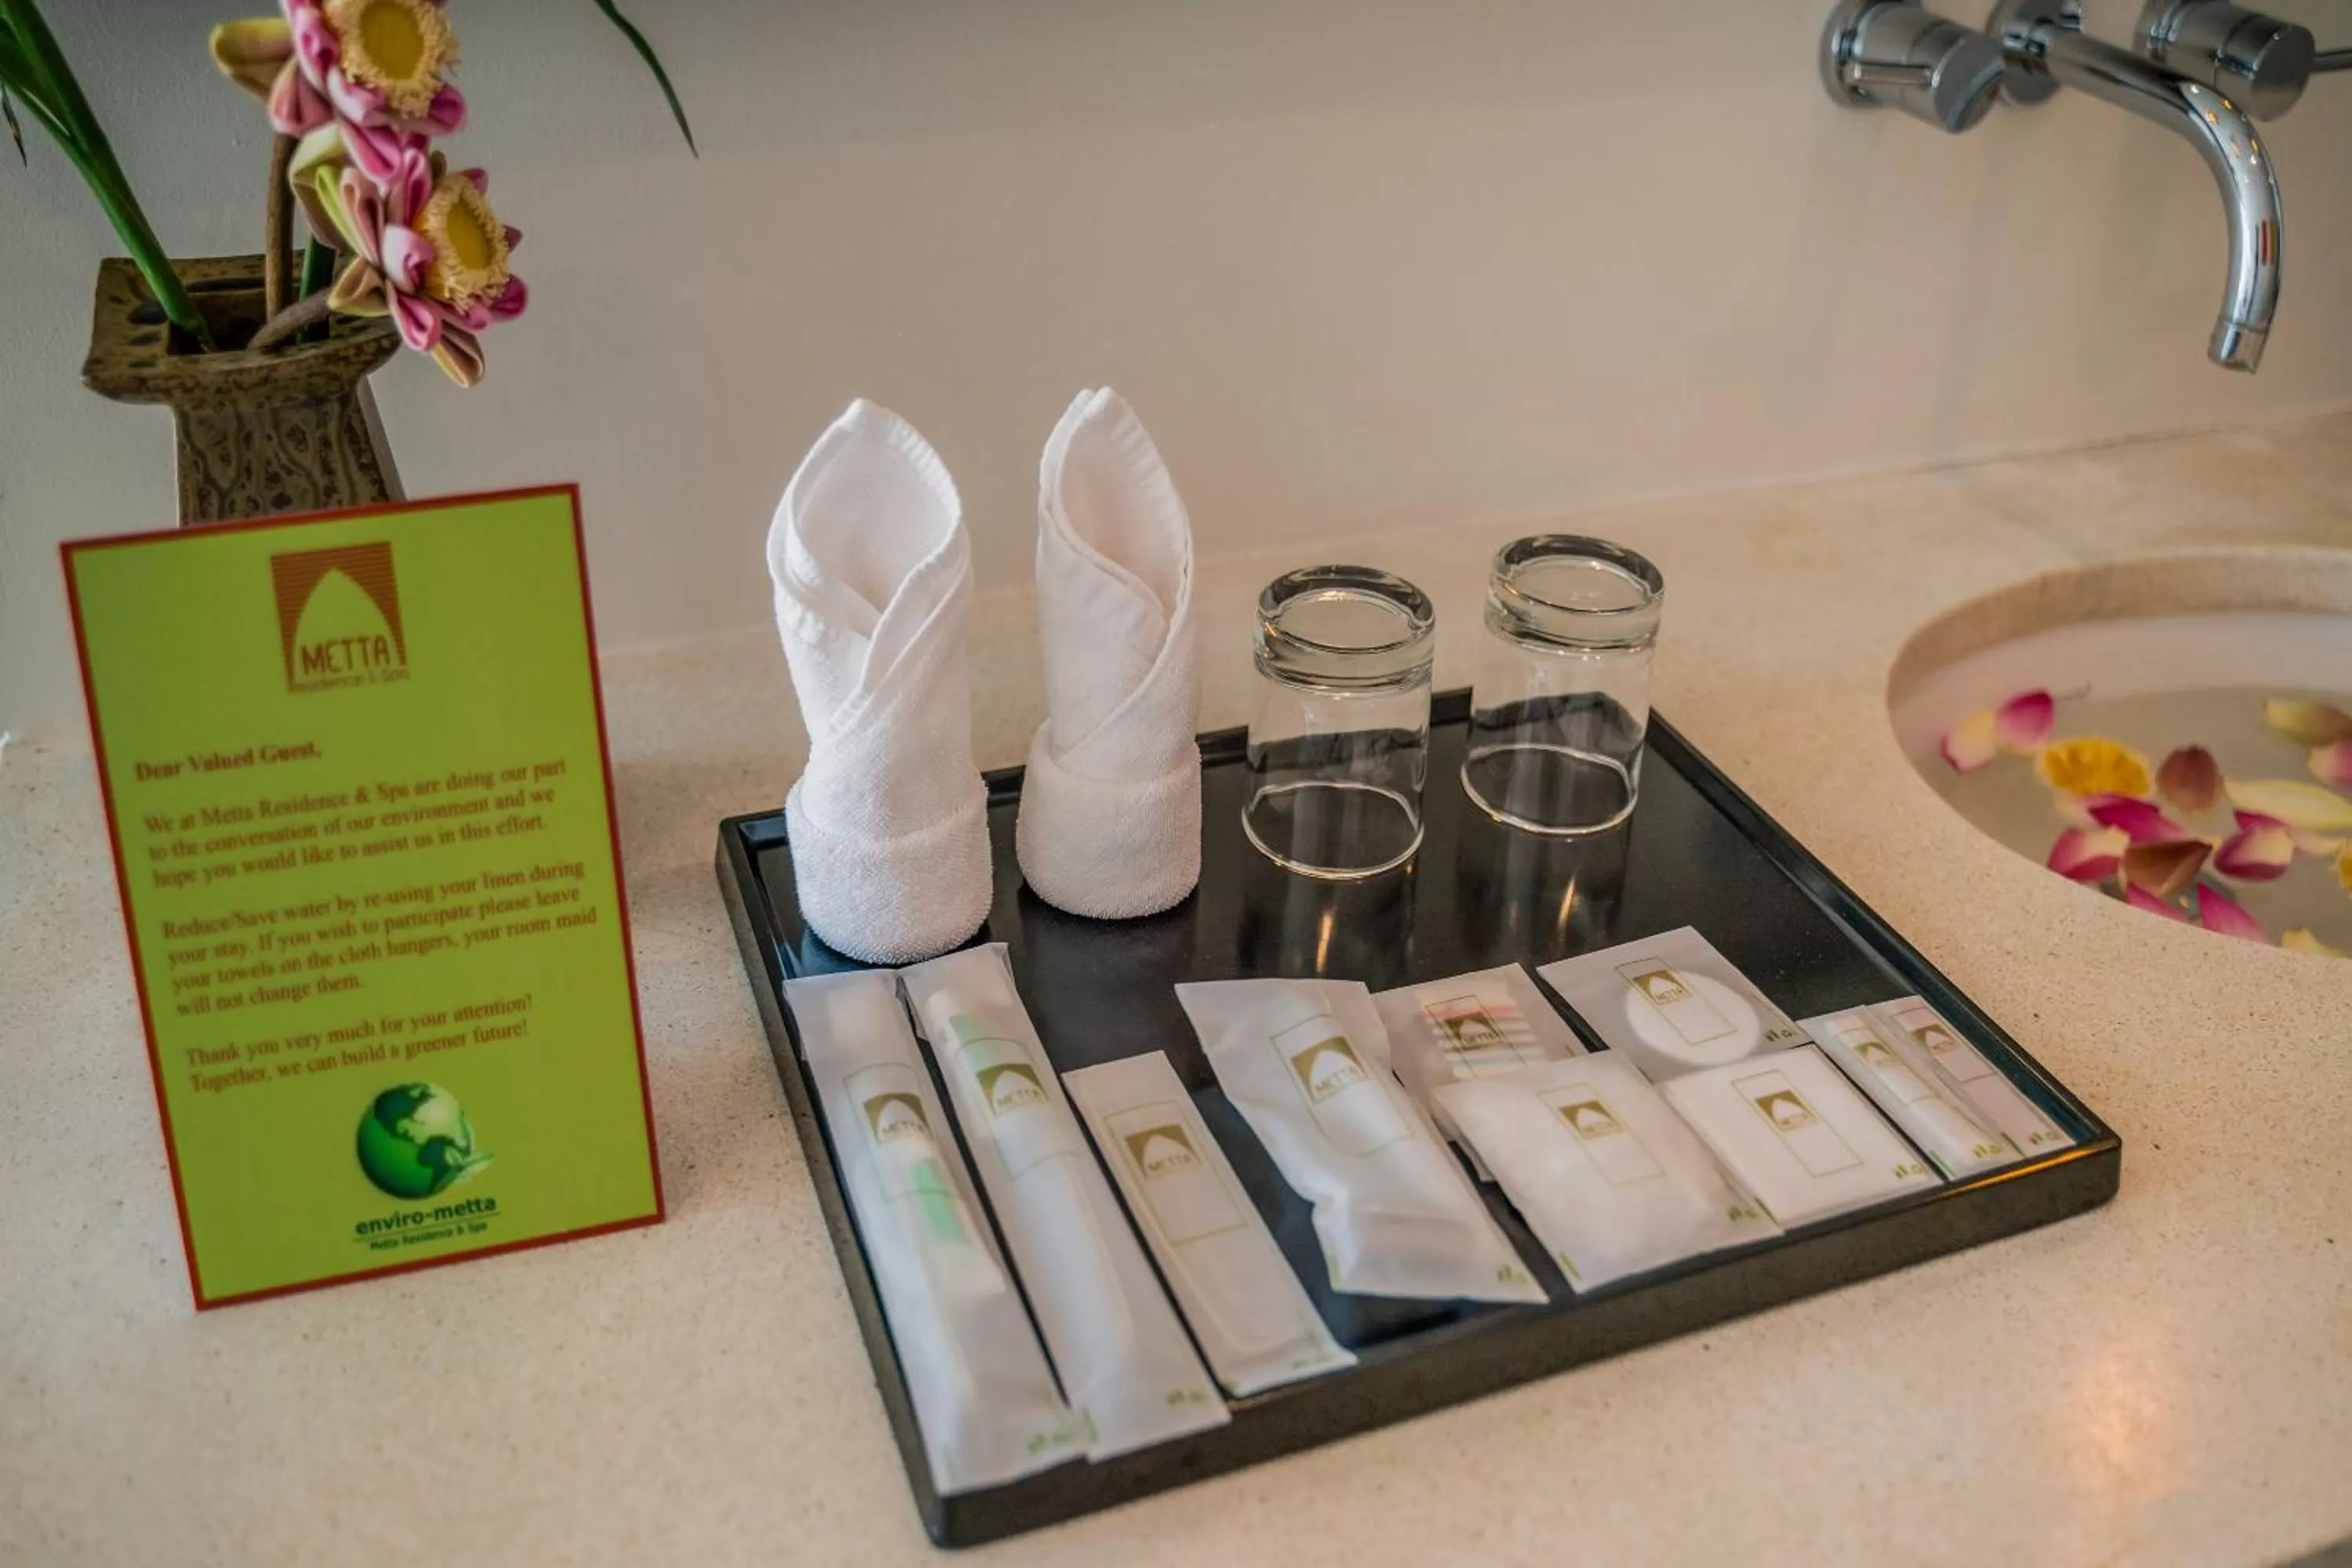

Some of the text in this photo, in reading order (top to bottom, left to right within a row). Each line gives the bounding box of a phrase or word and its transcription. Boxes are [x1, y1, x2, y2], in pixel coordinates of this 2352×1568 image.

[301, 634, 390, 675] METTA
[136, 742, 321, 781] Dear Valued Guest,
[145, 758, 566, 833] We at Metta Residence & Spa are doing our part
[149, 788, 555, 861] to the conversation of our environment and we
[153, 869, 195, 888] hope
[201, 865, 236, 884] you
[241, 851, 296, 873] would
[301, 845, 334, 866] like
[340, 846, 358, 859] to
[362, 836, 409, 856] assist
[415, 834, 434, 848] us
[439, 828, 455, 844] in
[459, 822, 491, 840] this
[284, 902, 332, 919] water
[336, 895, 358, 915] by
[363, 886, 435, 908] re-using
[439, 878, 477, 898] your
[482, 870, 524, 890] linen
[530, 862, 585, 882] during
[169, 947, 207, 971] your
[260, 931, 274, 950] If
[278, 931, 312, 952] you
[318, 920, 358, 941] wish
[362, 918, 379, 935] to
[385, 903, 474, 936] participate
[479, 895, 531, 920] please
[535, 887, 580, 906] leave
[173, 906, 598, 997] your towels on the cloth hangers, your room maid
[176, 995, 211, 1016] will
[216, 993, 244, 1011] not
[249, 984, 312, 1004] change
[186, 994, 532, 1066] Thank you very much for your attention!
[191, 1018, 528, 1093] Together, we can build a greener future!
[354, 1196, 497, 1236] enviro-metta
